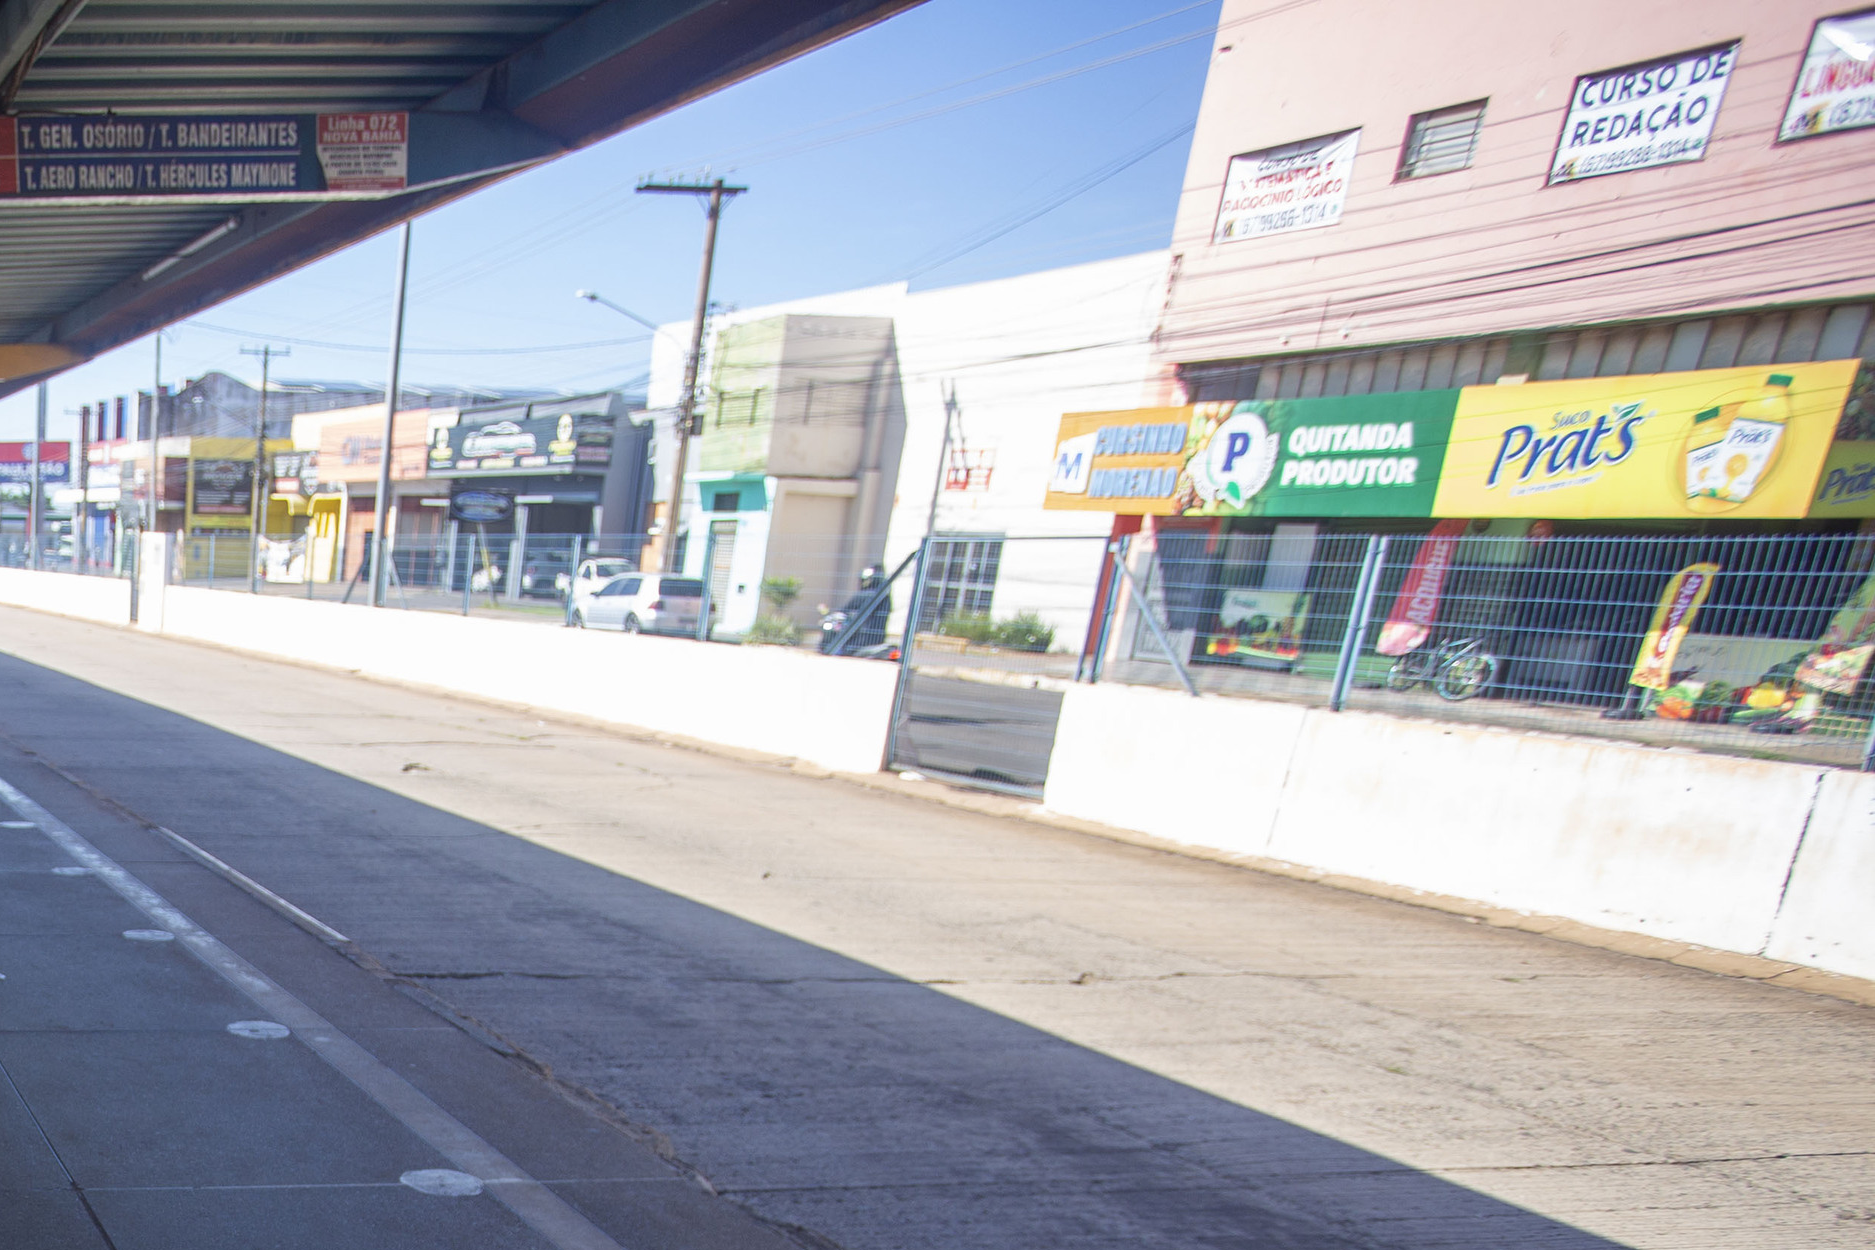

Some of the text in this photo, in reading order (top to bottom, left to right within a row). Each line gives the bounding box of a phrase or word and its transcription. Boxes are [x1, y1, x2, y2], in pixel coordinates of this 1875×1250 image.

[1581, 48, 1733, 107] CURSO DE
[21, 123, 35, 149] T.
[39, 122, 78, 149] GEN.
[82, 118, 145, 149] OSÓRIO
[177, 122, 298, 148] BANDEIRANTES
[328, 115, 397, 132] Linha 072
[1570, 92, 1710, 148] REDAÇÃO
[322, 131, 358, 142] NOVA
[25, 166, 37, 190] T.
[40, 166, 74, 189] AERO
[78, 164, 134, 189] RANCHO
[160, 159, 227, 189] HÉRCULES
[230, 162, 297, 187] MAYMONE
[1550, 410, 1592, 431] Suco
[1221, 432, 1251, 472] P
[1288, 422, 1415, 457] QUITANDA
[1279, 457, 1419, 487] PRODUTOR
